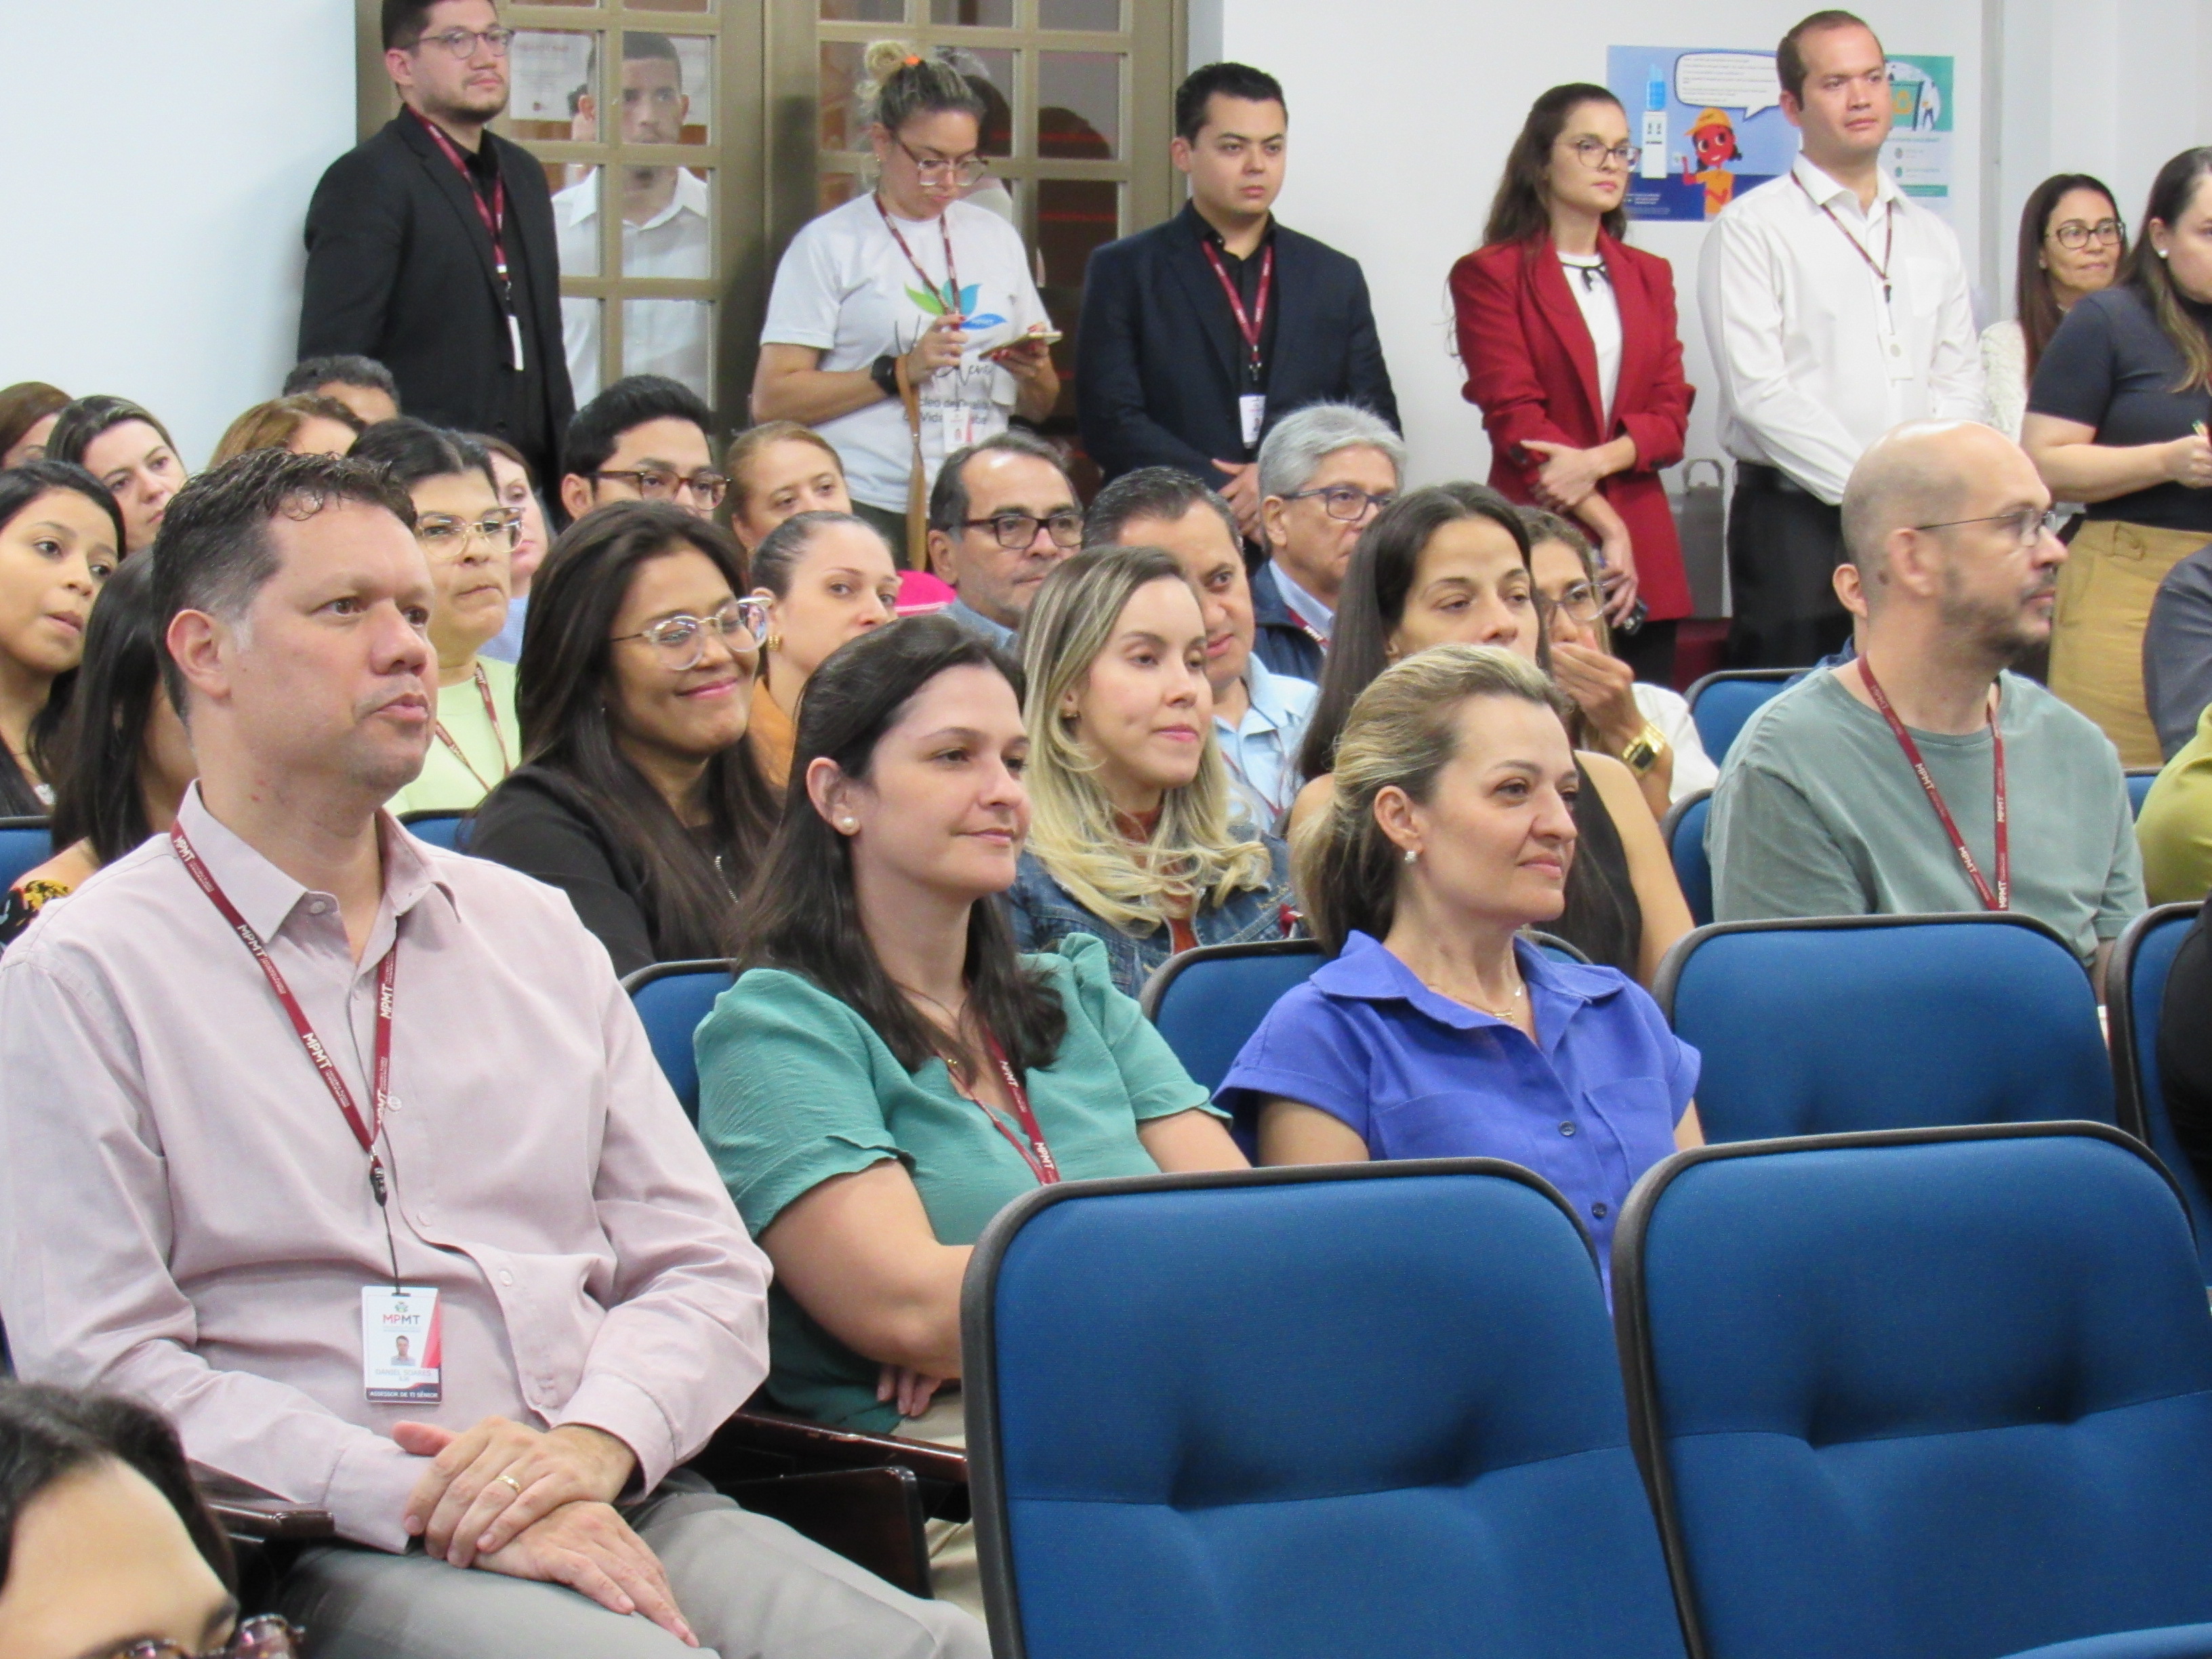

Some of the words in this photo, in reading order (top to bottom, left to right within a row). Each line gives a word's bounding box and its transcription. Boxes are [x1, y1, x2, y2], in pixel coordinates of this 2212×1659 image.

[1915, 762, 1935, 790] MPMT
[1996, 794, 2005, 822] MPMT
[173, 835, 196, 862] MPMT
[1958, 846, 1978, 873] MPMT
[1998, 880, 2007, 908] MPMT
[237, 924, 268, 957] MPMT
[380, 983, 394, 1019] MPMT
[302, 1032, 333, 1069] MPMT
[999, 1060, 1019, 1088] MPMT
[1033, 1142, 1054, 1170] MPMT
[382, 1314, 420, 1324] MPMT
